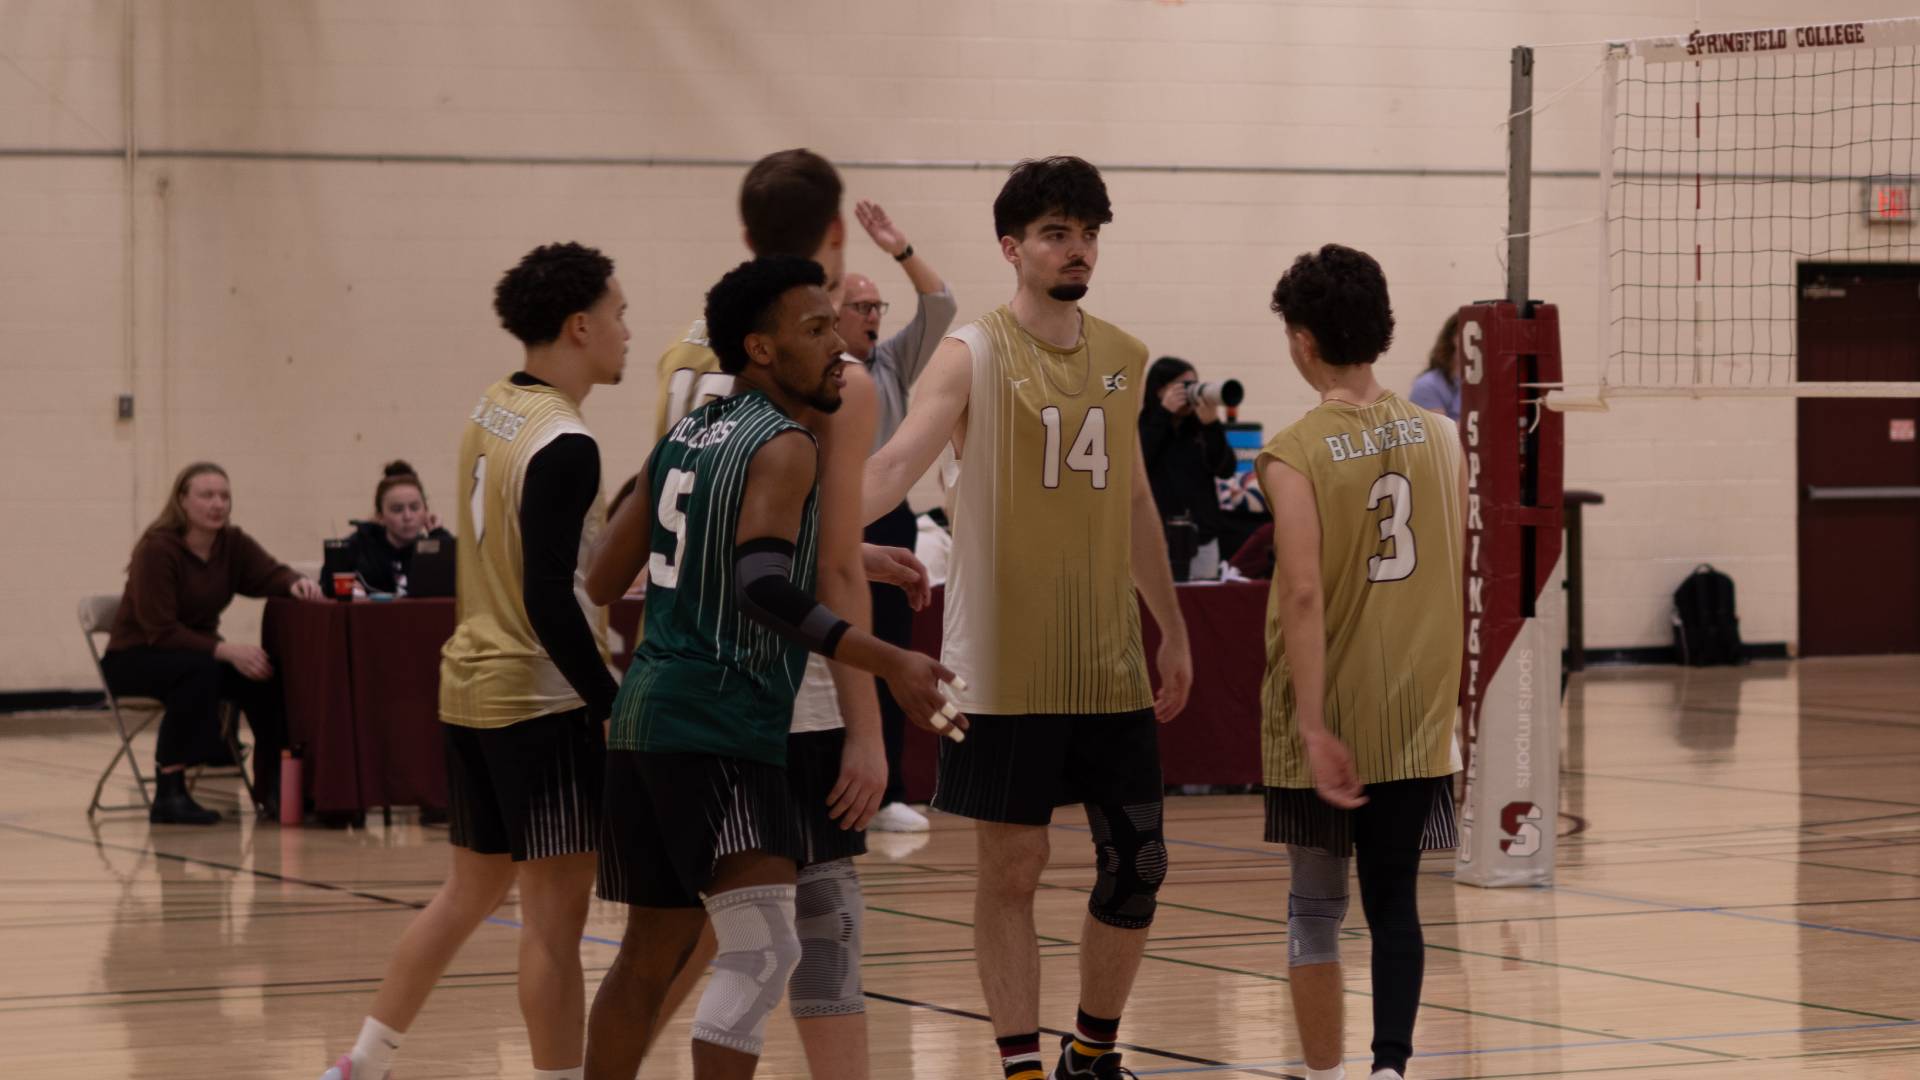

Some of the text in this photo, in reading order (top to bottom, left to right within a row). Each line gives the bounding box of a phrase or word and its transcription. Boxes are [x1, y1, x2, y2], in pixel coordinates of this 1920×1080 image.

[1687, 23, 1864, 55] SPRINGFIELD COLLEGE
[1462, 321, 1483, 384] S
[667, 368, 736, 432] 1
[668, 416, 737, 448] BLZERS
[1041, 406, 1109, 489] 14
[1325, 416, 1425, 462] BLAZERS
[648, 468, 696, 589] 5
[1366, 472, 1417, 583] 3
[1515, 648, 1534, 789] sports imports
[1500, 801, 1543, 857] S
